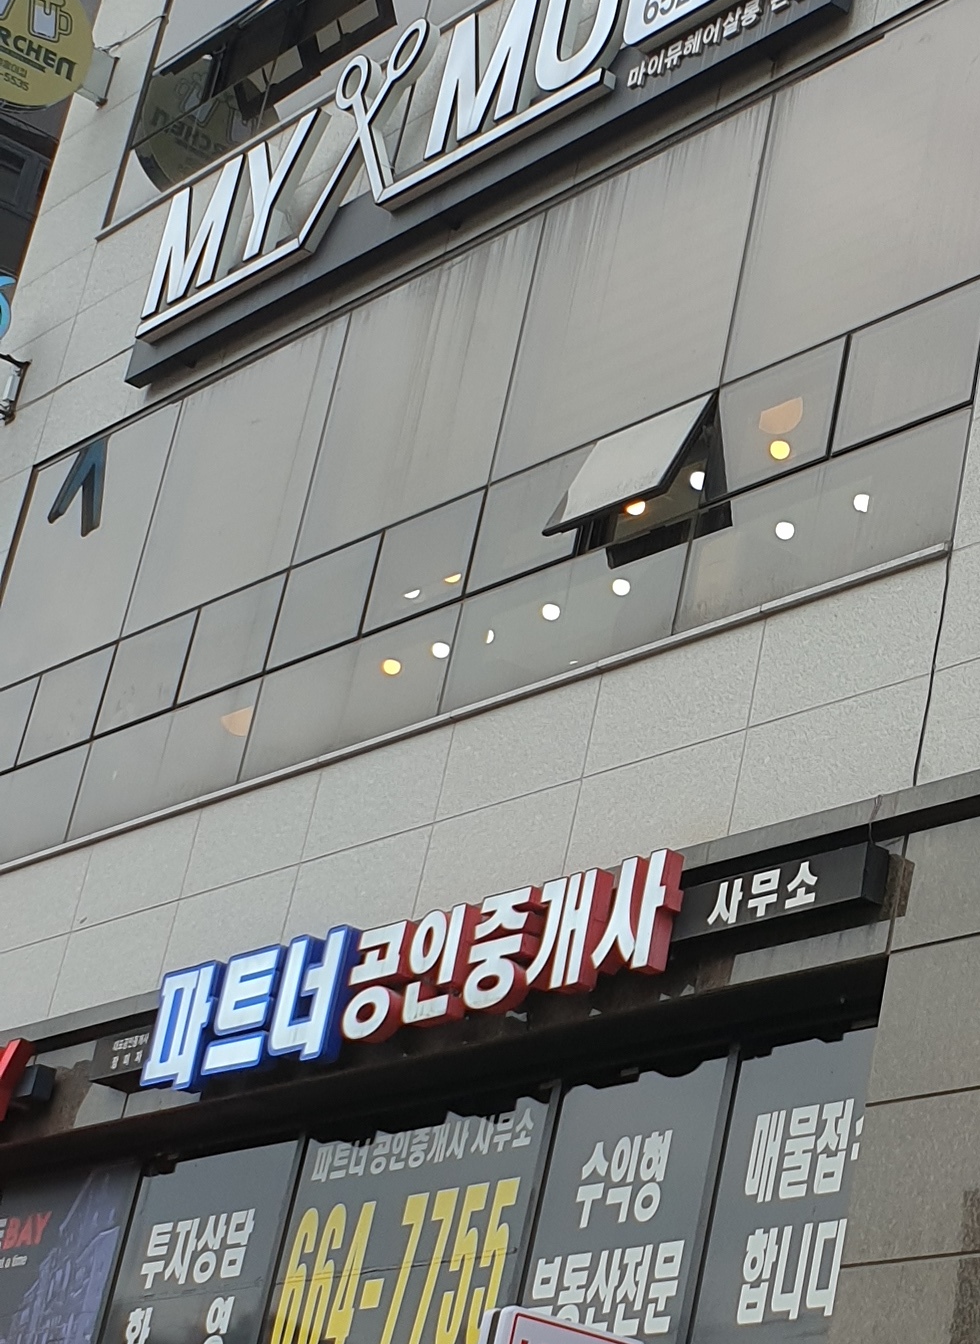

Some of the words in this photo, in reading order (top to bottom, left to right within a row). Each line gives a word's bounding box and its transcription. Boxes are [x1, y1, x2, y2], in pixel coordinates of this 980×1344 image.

[140, 106, 323, 319] MY
[141, 922, 355, 1090] 파트너
[341, 848, 678, 1044] 공인중개사
[706, 861, 820, 928] 사무소
[311, 1139, 371, 1183] 파트너
[370, 1116, 470, 1175] 공인중개사
[471, 1106, 536, 1159] 사무소
[576, 1130, 674, 1229] 수익형
[745, 1097, 865, 1204] 매물접
[140, 1207, 256, 1290] 투자상담
[530, 1240, 685, 1336] 부동산전문
